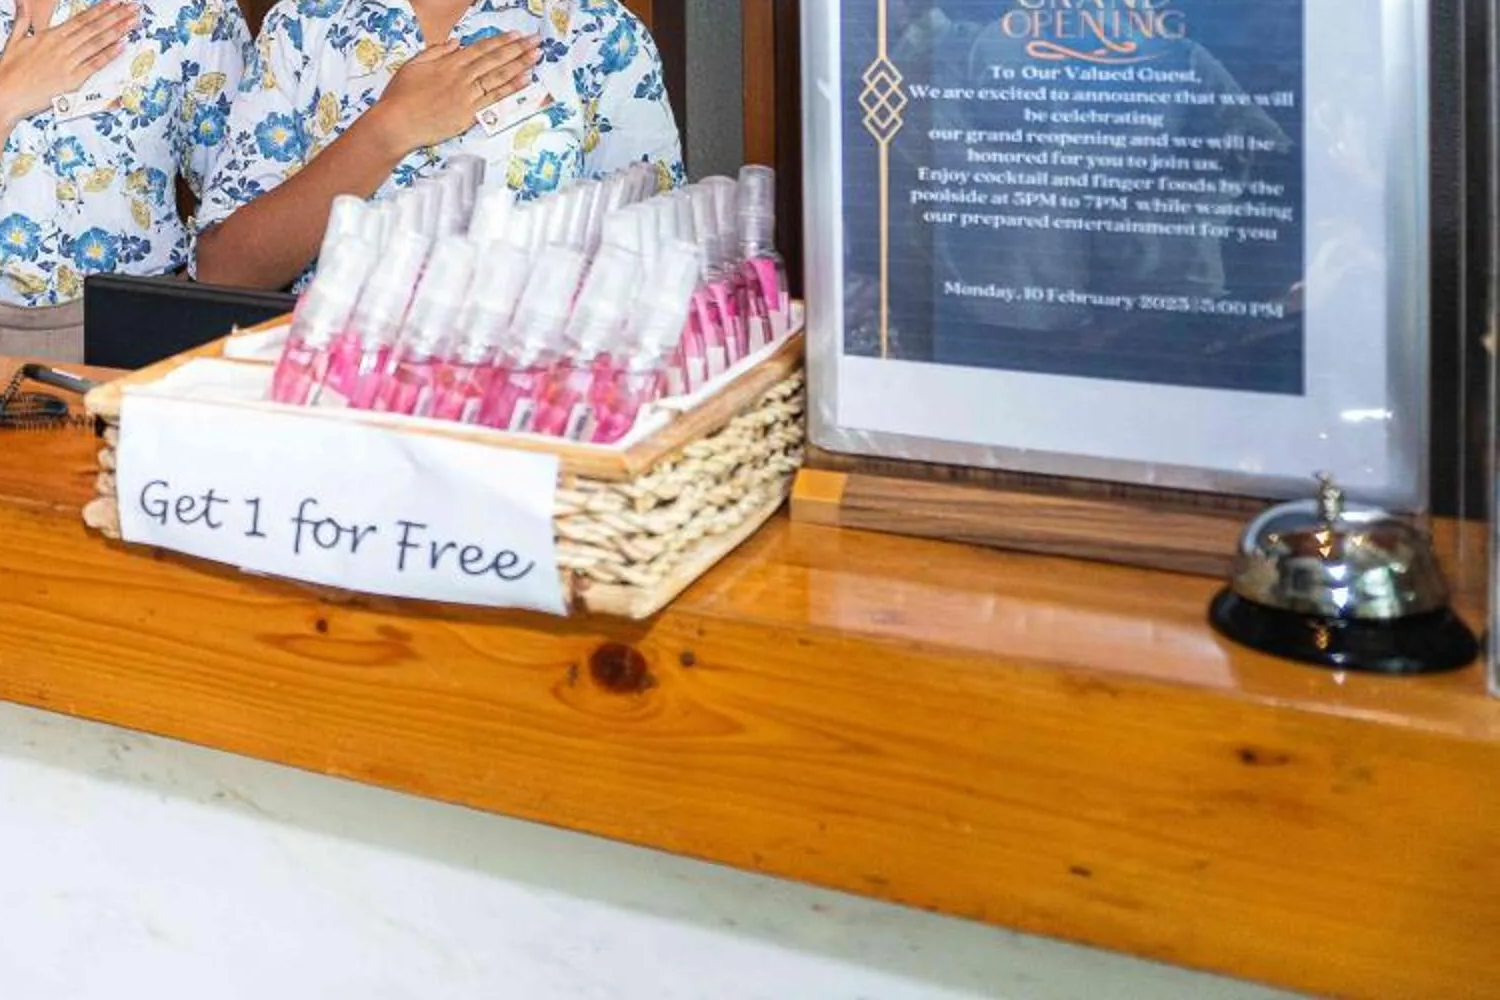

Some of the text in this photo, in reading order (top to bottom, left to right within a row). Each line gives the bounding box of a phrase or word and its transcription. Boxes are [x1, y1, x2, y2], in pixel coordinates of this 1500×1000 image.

[1002, 9, 1187, 40] OPENING
[990, 65, 1015, 79] To
[1022, 65, 1062, 80] Our
[1064, 66, 1134, 81] Valued
[908, 84, 1294, 107] We are excited to announce that we will
[1023, 107, 1165, 128] be celebrating
[928, 128, 963, 141] our
[965, 128, 1023, 145] grand
[1025, 130, 1127, 149] reopening
[1129, 133, 1169, 147] and
[1171, 136, 1202, 148] we
[1206, 134, 1245, 149] will
[966, 147, 1048, 164] honored
[1050, 150, 1083, 165] for
[1085, 153, 1124, 170] you
[1126, 155, 1148, 168] to
[1150, 153, 1190, 172] join
[917, 166, 1284, 197] Enjoy cocktail and finger foods by the
[910, 188, 1293, 221] poolside at 5PM to 7PM while watching
[922, 211, 1277, 242] our prepared entertainment for you
[944, 281, 1021, 303] Monday,
[1023, 286, 1044, 300] 10
[1045, 287, 1133, 311] February
[1138, 294, 1190, 311] 2025
[1250, 301, 1284, 318] PM
[139, 479, 535, 582] Get 1 for Free
